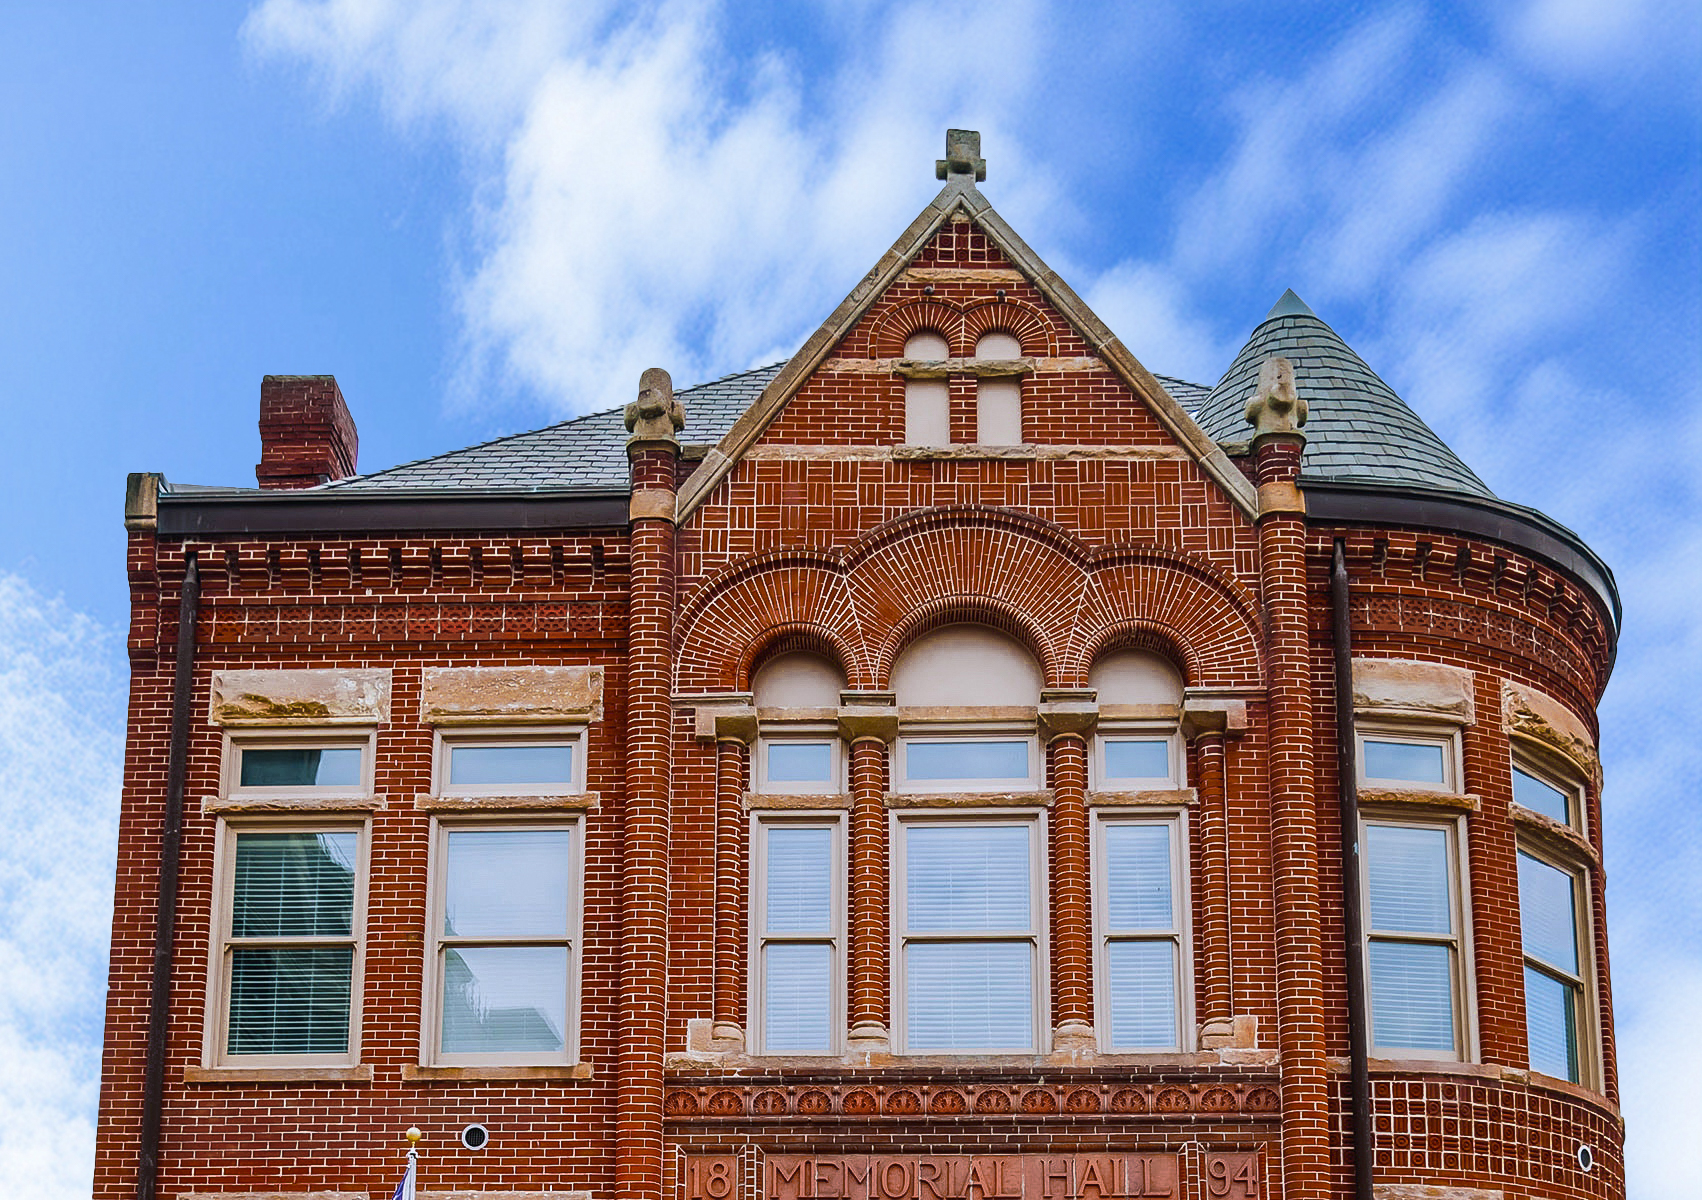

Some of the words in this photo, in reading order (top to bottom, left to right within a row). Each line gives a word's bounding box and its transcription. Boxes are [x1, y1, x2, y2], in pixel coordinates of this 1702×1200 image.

[690, 1160, 731, 1199] 18
[769, 1159, 1021, 1199] MEMORIAL
[1040, 1158, 1172, 1198] HALL
[1208, 1157, 1257, 1197] 94
